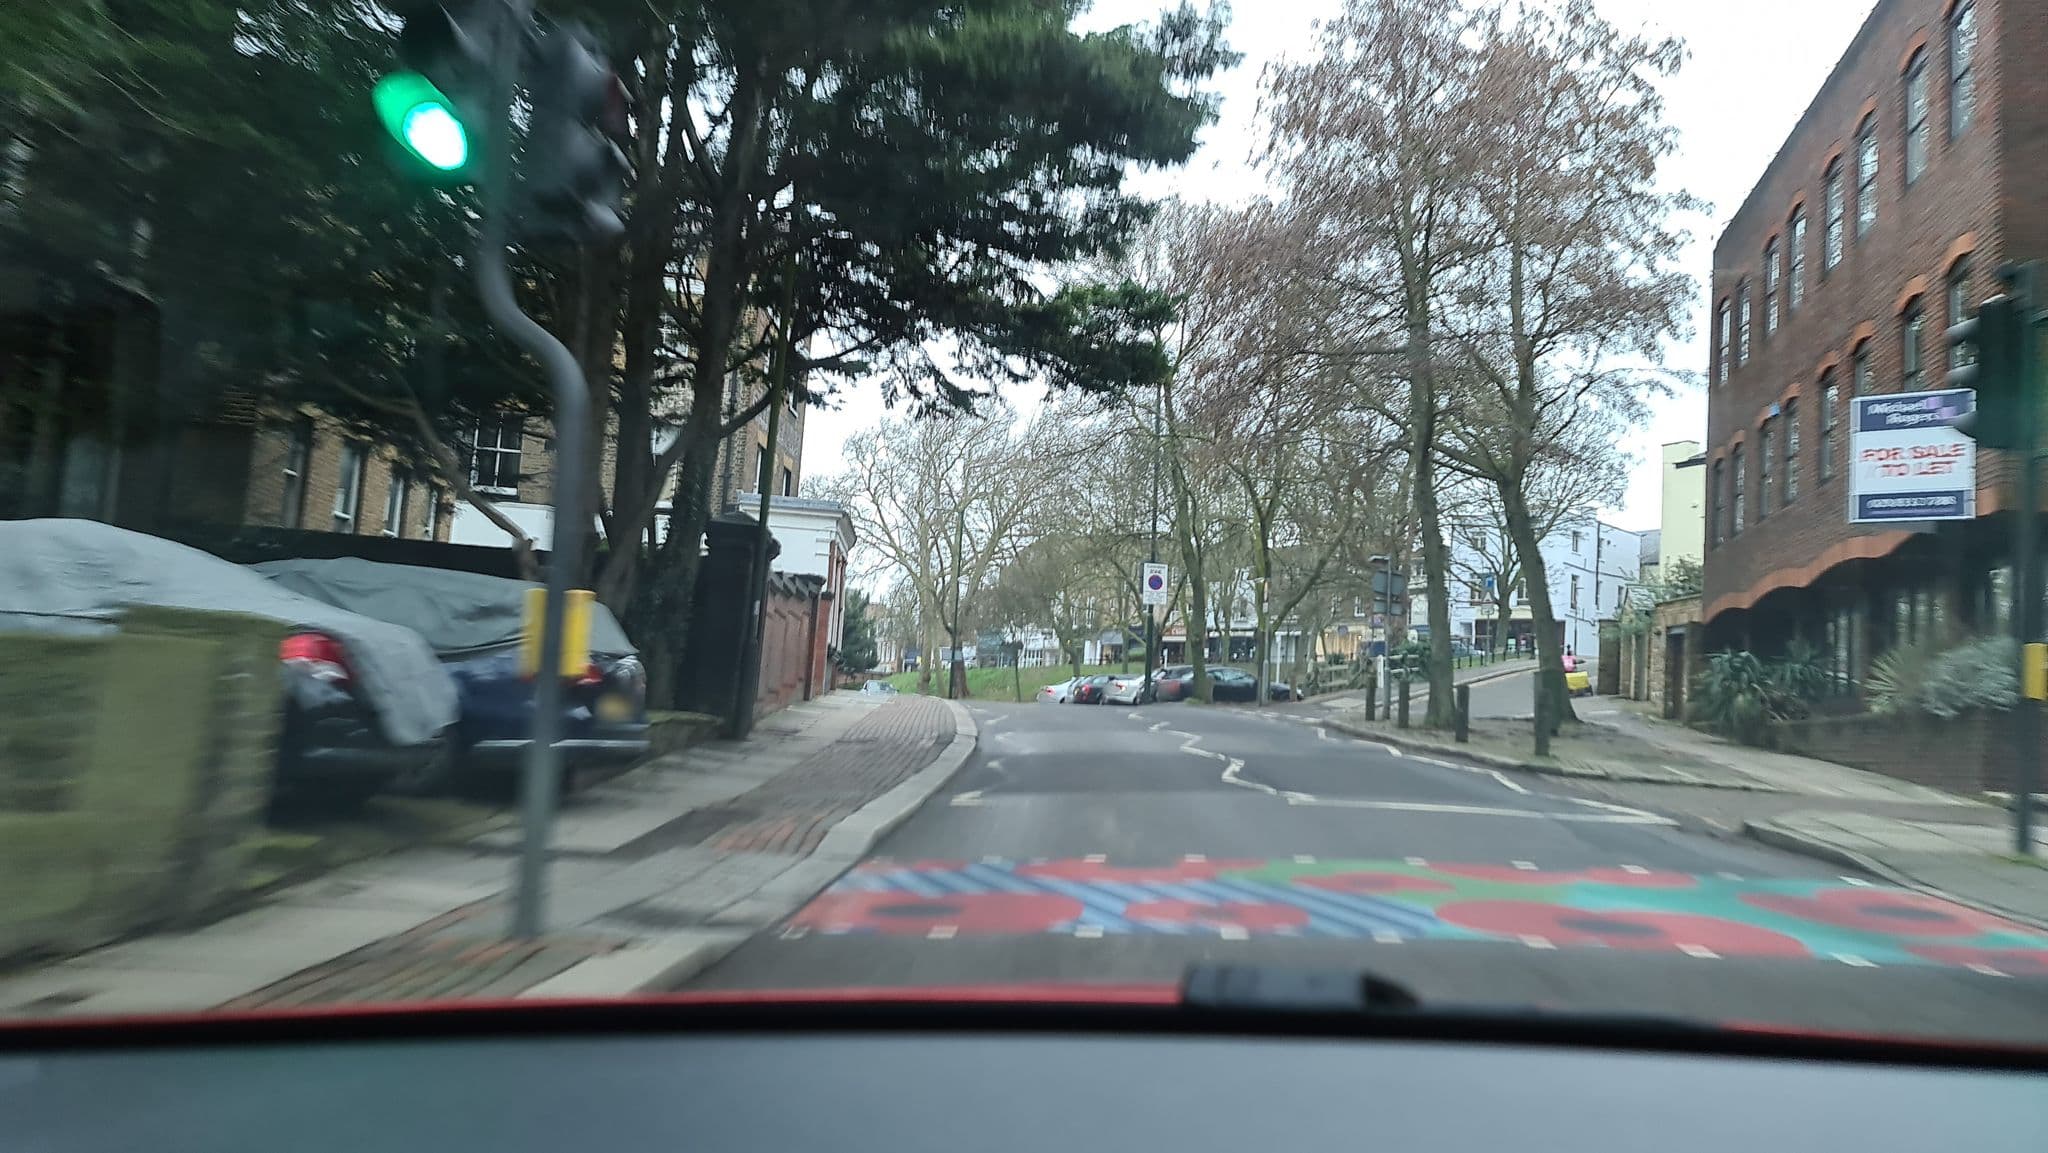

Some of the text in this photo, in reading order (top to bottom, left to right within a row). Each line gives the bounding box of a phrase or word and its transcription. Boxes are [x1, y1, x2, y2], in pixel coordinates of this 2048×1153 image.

[1859, 443, 1967, 462] FOR SALE
[1876, 461, 1957, 477] TO LET
